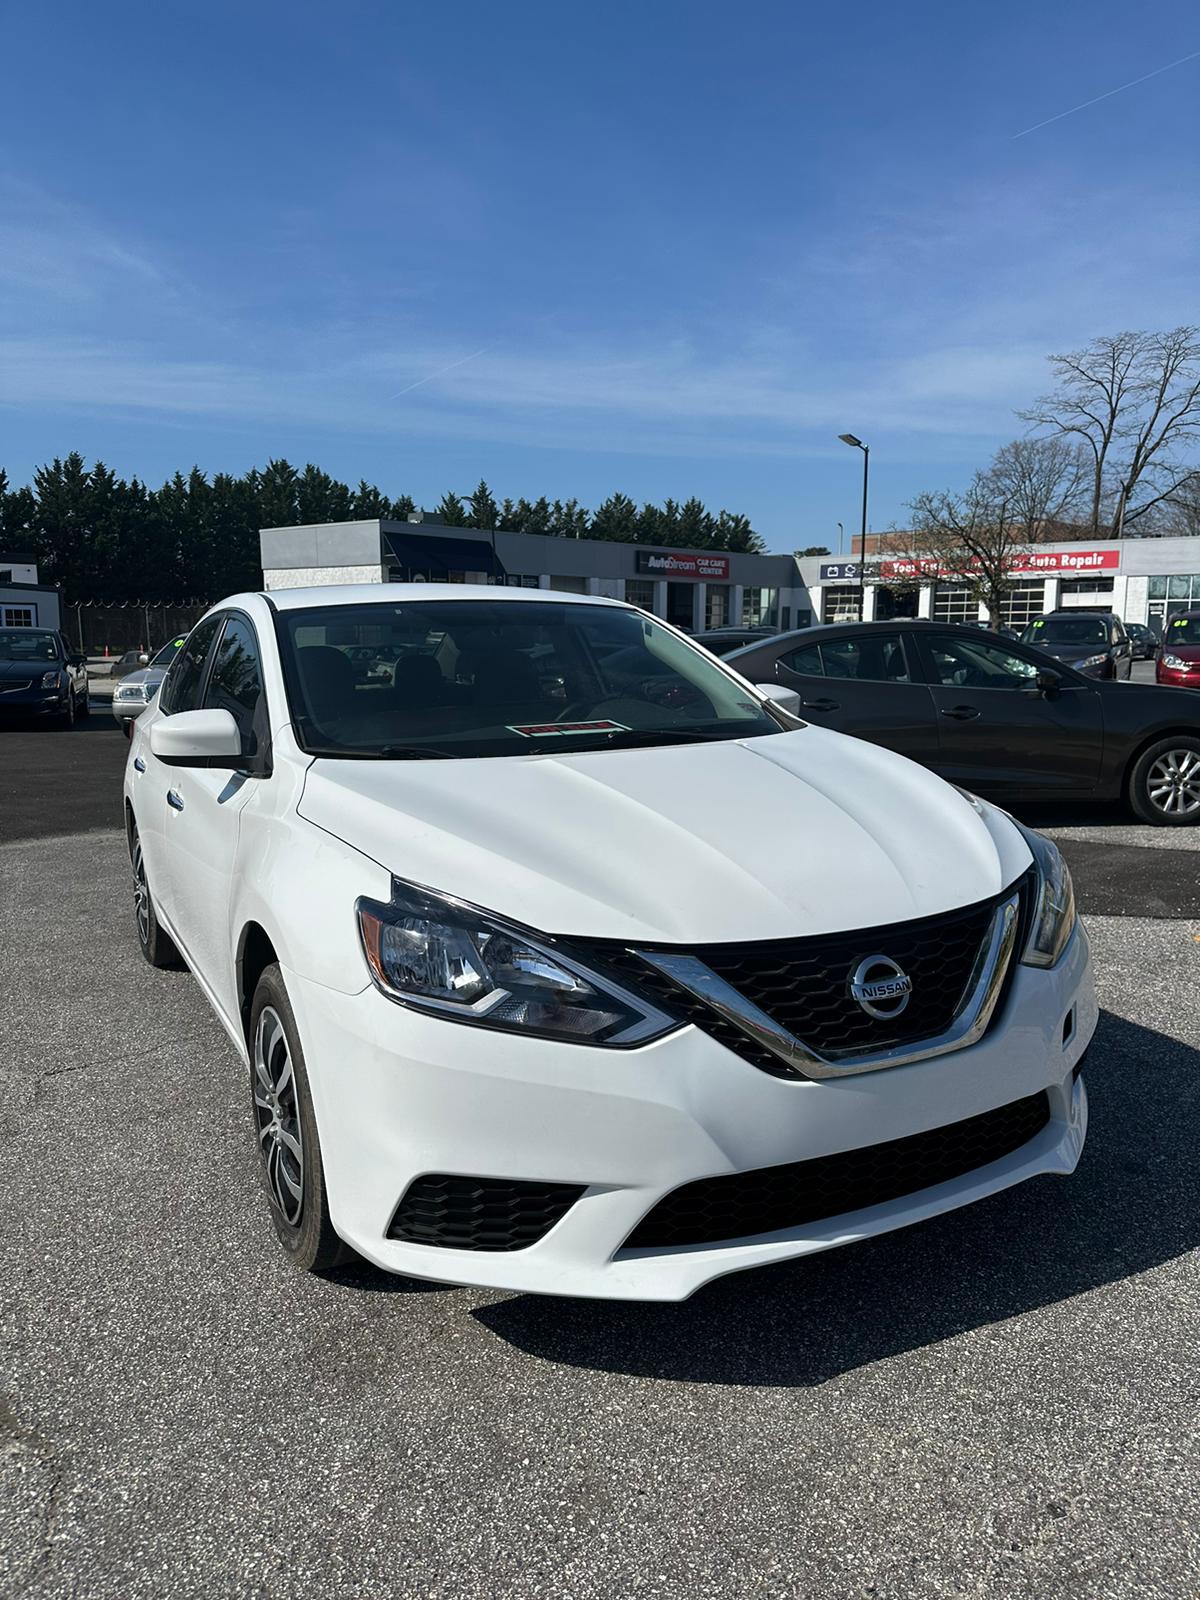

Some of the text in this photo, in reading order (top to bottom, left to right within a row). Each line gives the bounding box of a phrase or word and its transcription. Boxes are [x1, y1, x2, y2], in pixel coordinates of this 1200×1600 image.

[648, 556, 696, 571] AutoStream
[697, 558, 725, 568] CAR CARE
[1061, 553, 1104, 568] Repair
[699, 567, 722, 575] CENTER
[862, 979, 911, 998] NISSAN
